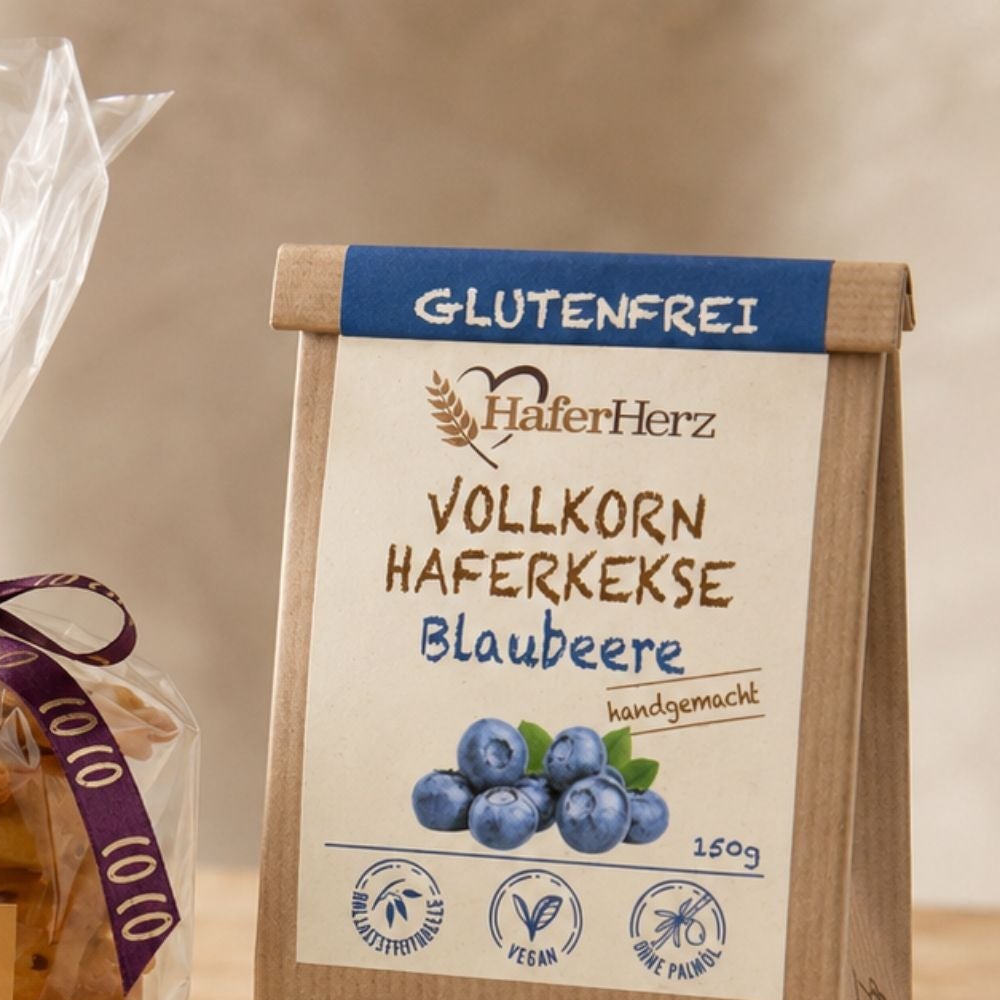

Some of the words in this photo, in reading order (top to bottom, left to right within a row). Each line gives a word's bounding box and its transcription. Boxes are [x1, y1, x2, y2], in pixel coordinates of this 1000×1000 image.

[414, 287, 759, 336] GLUTENFREI
[481, 394, 717, 440] HaferHerz
[428, 476, 705, 544] VOLLKORN
[386, 545, 736, 608] HAFERKEKSE
[421, 610, 686, 675] Blaubeere
[607, 682, 761, 723] handgemacht
[693, 836, 761, 869] 150g
[507, 943, 558, 967] VEGAN
